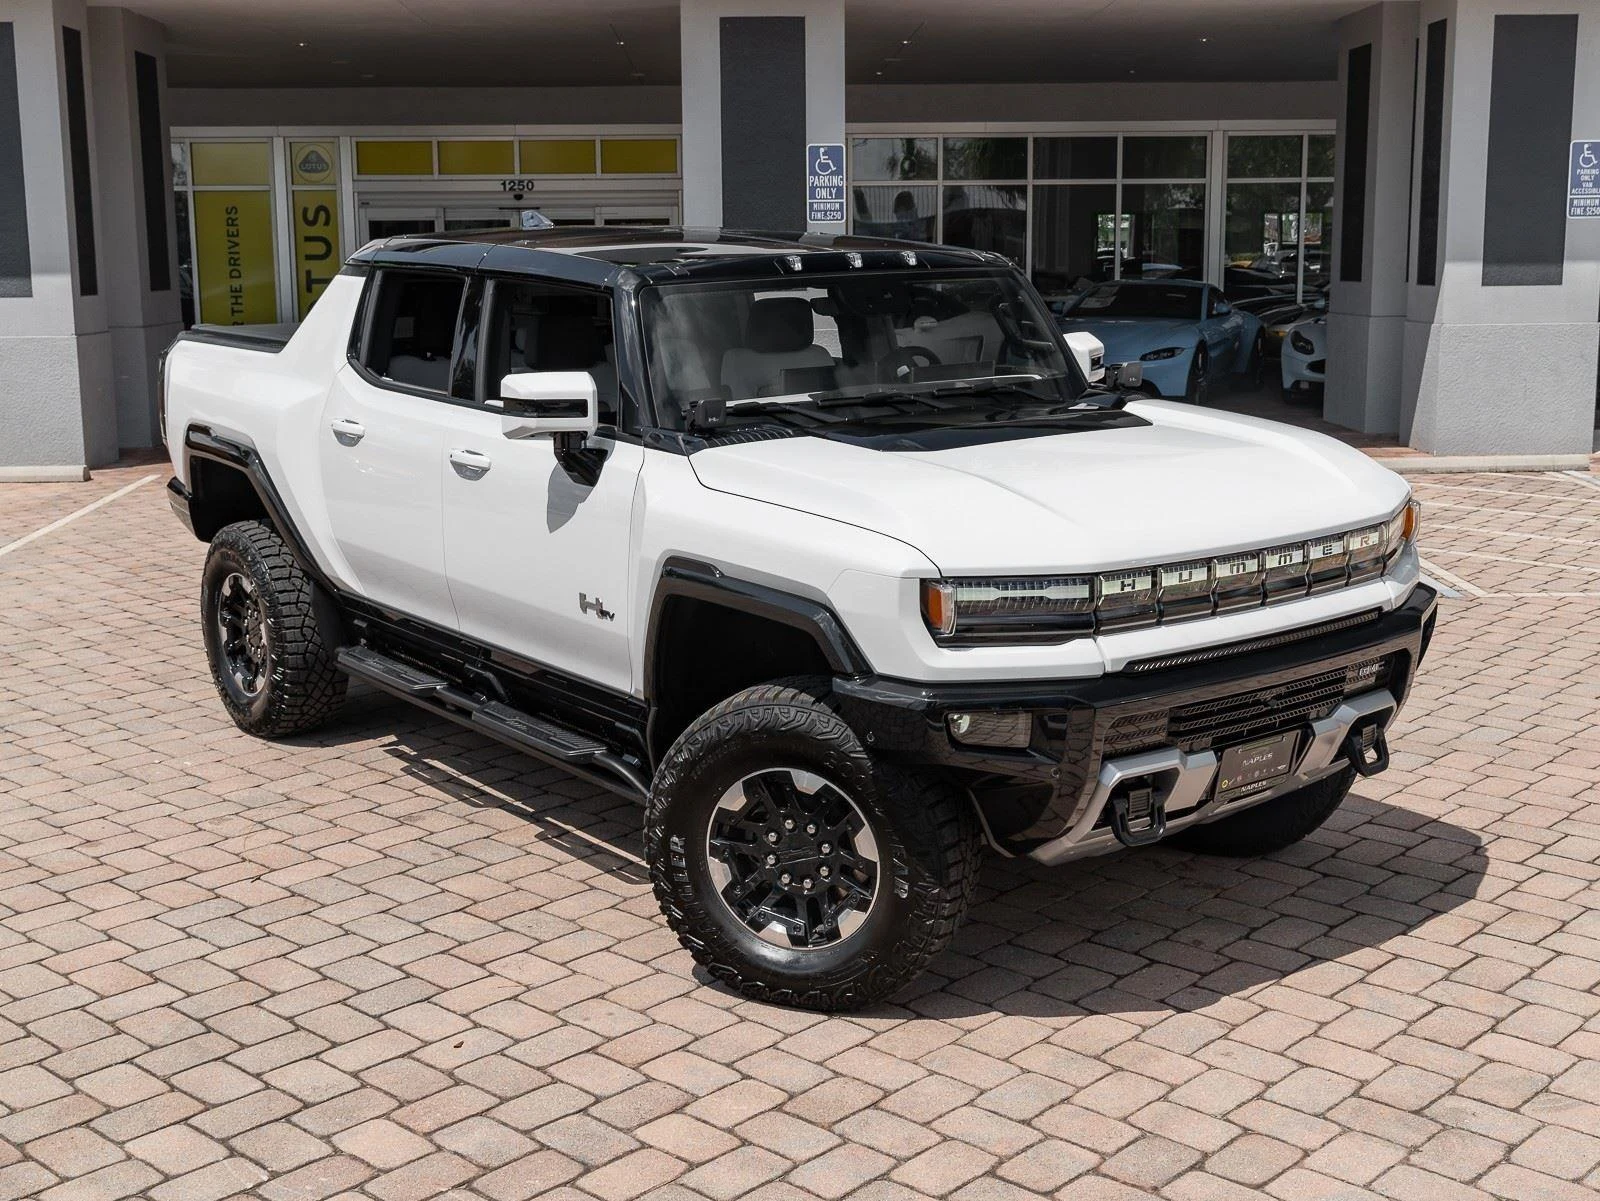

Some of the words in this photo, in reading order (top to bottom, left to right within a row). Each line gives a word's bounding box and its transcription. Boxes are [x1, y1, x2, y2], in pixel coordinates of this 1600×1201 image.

[299, 162, 329, 171] LOTUS
[1576, 168, 1600, 176] PARKING
[500, 180, 535, 192] 1250
[809, 175, 843, 187] PARKING
[815, 187, 837, 199] ONLY
[1571, 187, 1600, 195] ACCESSIBL
[813, 202, 840, 211] MINIMUM
[1573, 198, 1600, 207] MINIMUM
[811, 211, 826, 220] FINE
[826, 211, 842, 221] $250
[1571, 207, 1584, 216] FINE
[225, 205, 242, 279] DRIVERS
[302, 204, 333, 312] TUS
[230, 283, 245, 317] THE
[1120, 535, 1374, 592] HUMMER
[1359, 661, 1385, 676] GMC
[1242, 752, 1273, 767] NAPLES
